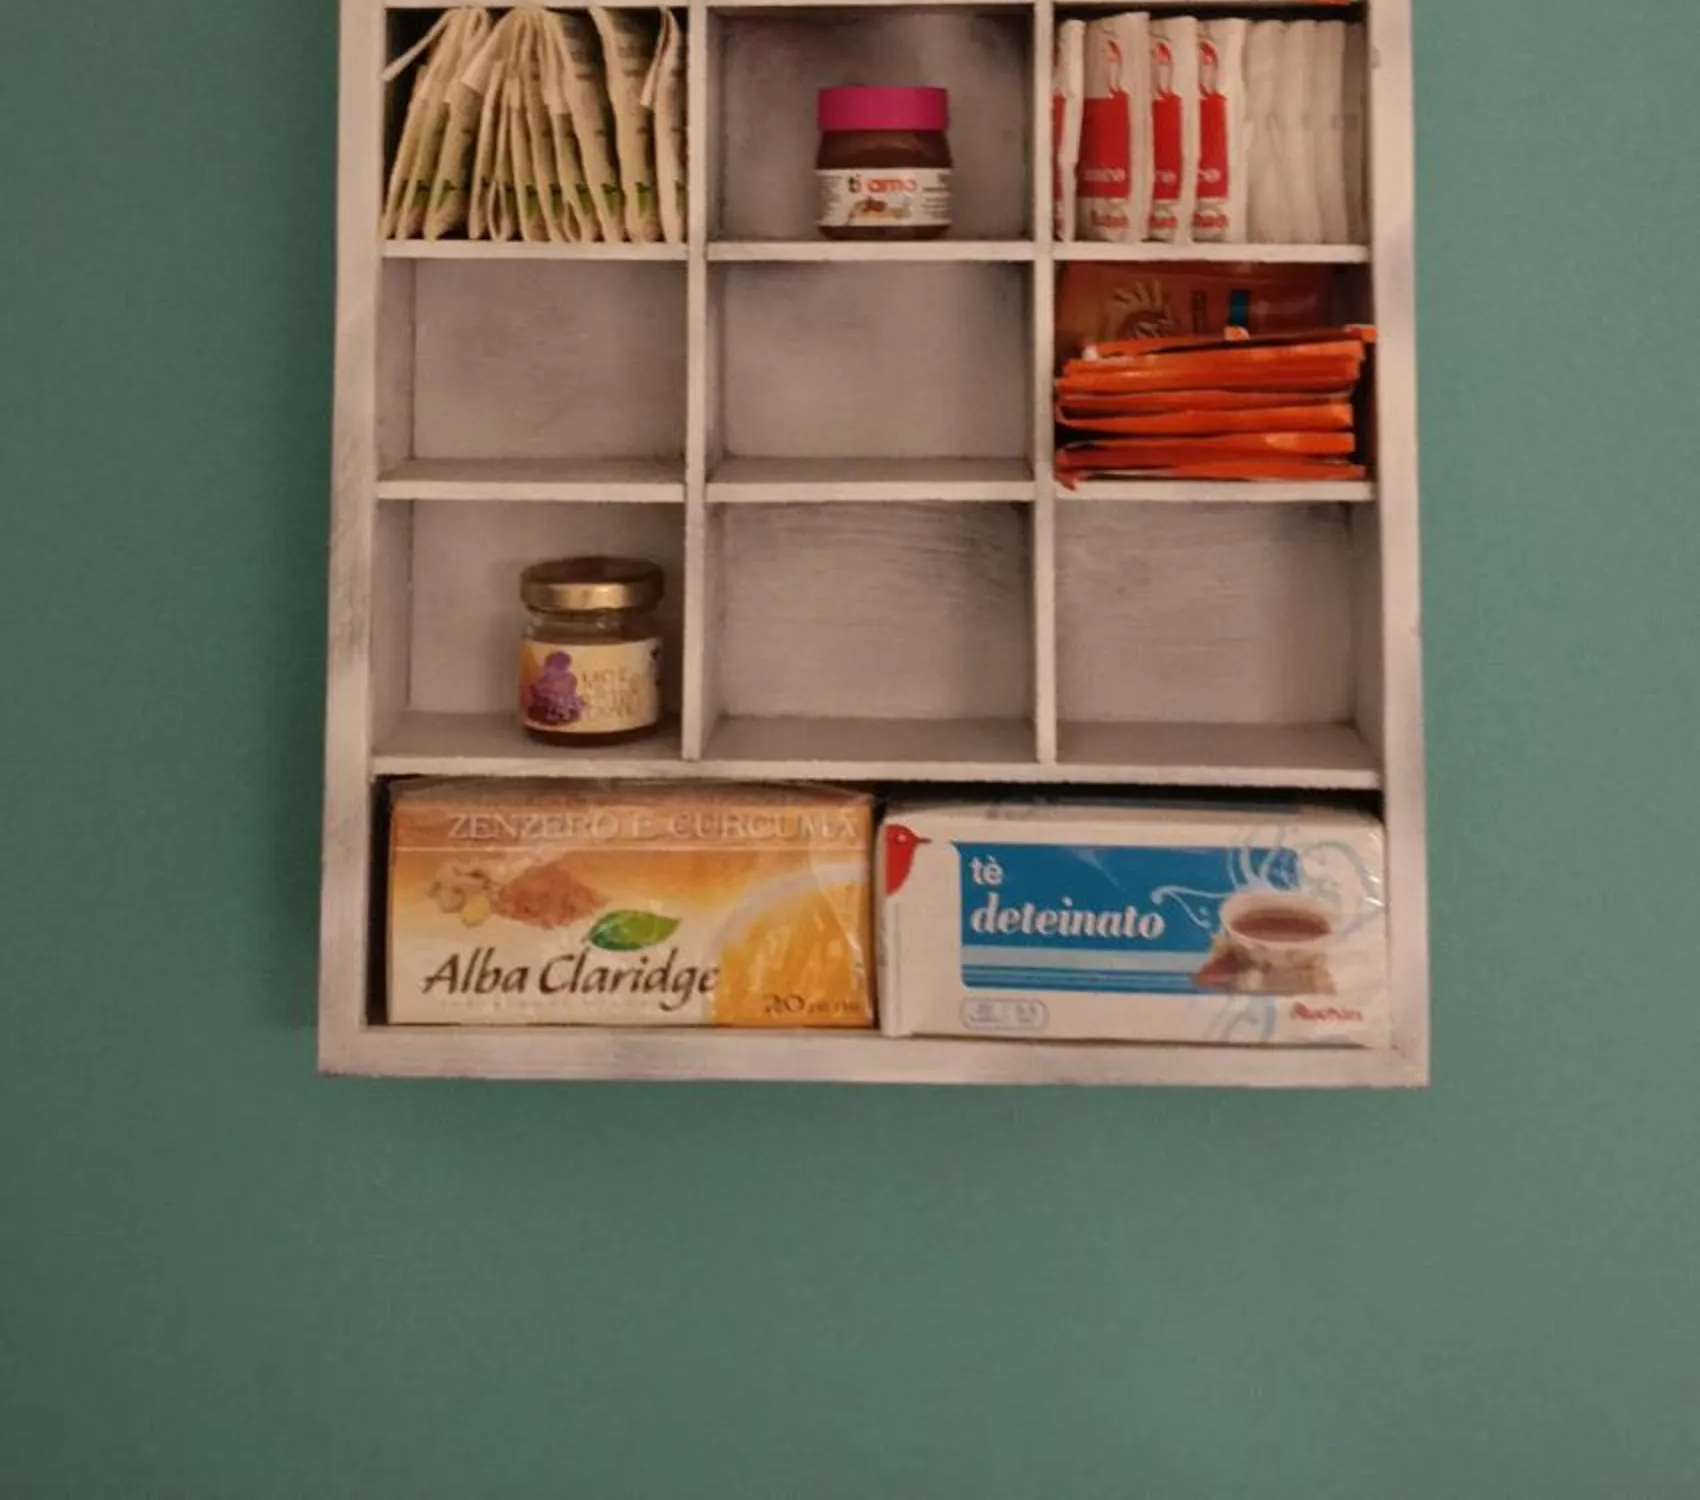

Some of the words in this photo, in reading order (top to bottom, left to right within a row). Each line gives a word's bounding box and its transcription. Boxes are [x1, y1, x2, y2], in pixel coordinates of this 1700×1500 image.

[447, 810, 620, 841] ZENZERO
[629, 810, 655, 840] E
[668, 807, 858, 840] CURCUMA
[969, 854, 1004, 886] tè
[969, 892, 1166, 940] deteinato
[422, 947, 529, 995] Alba
[538, 946, 722, 1012] Claridge
